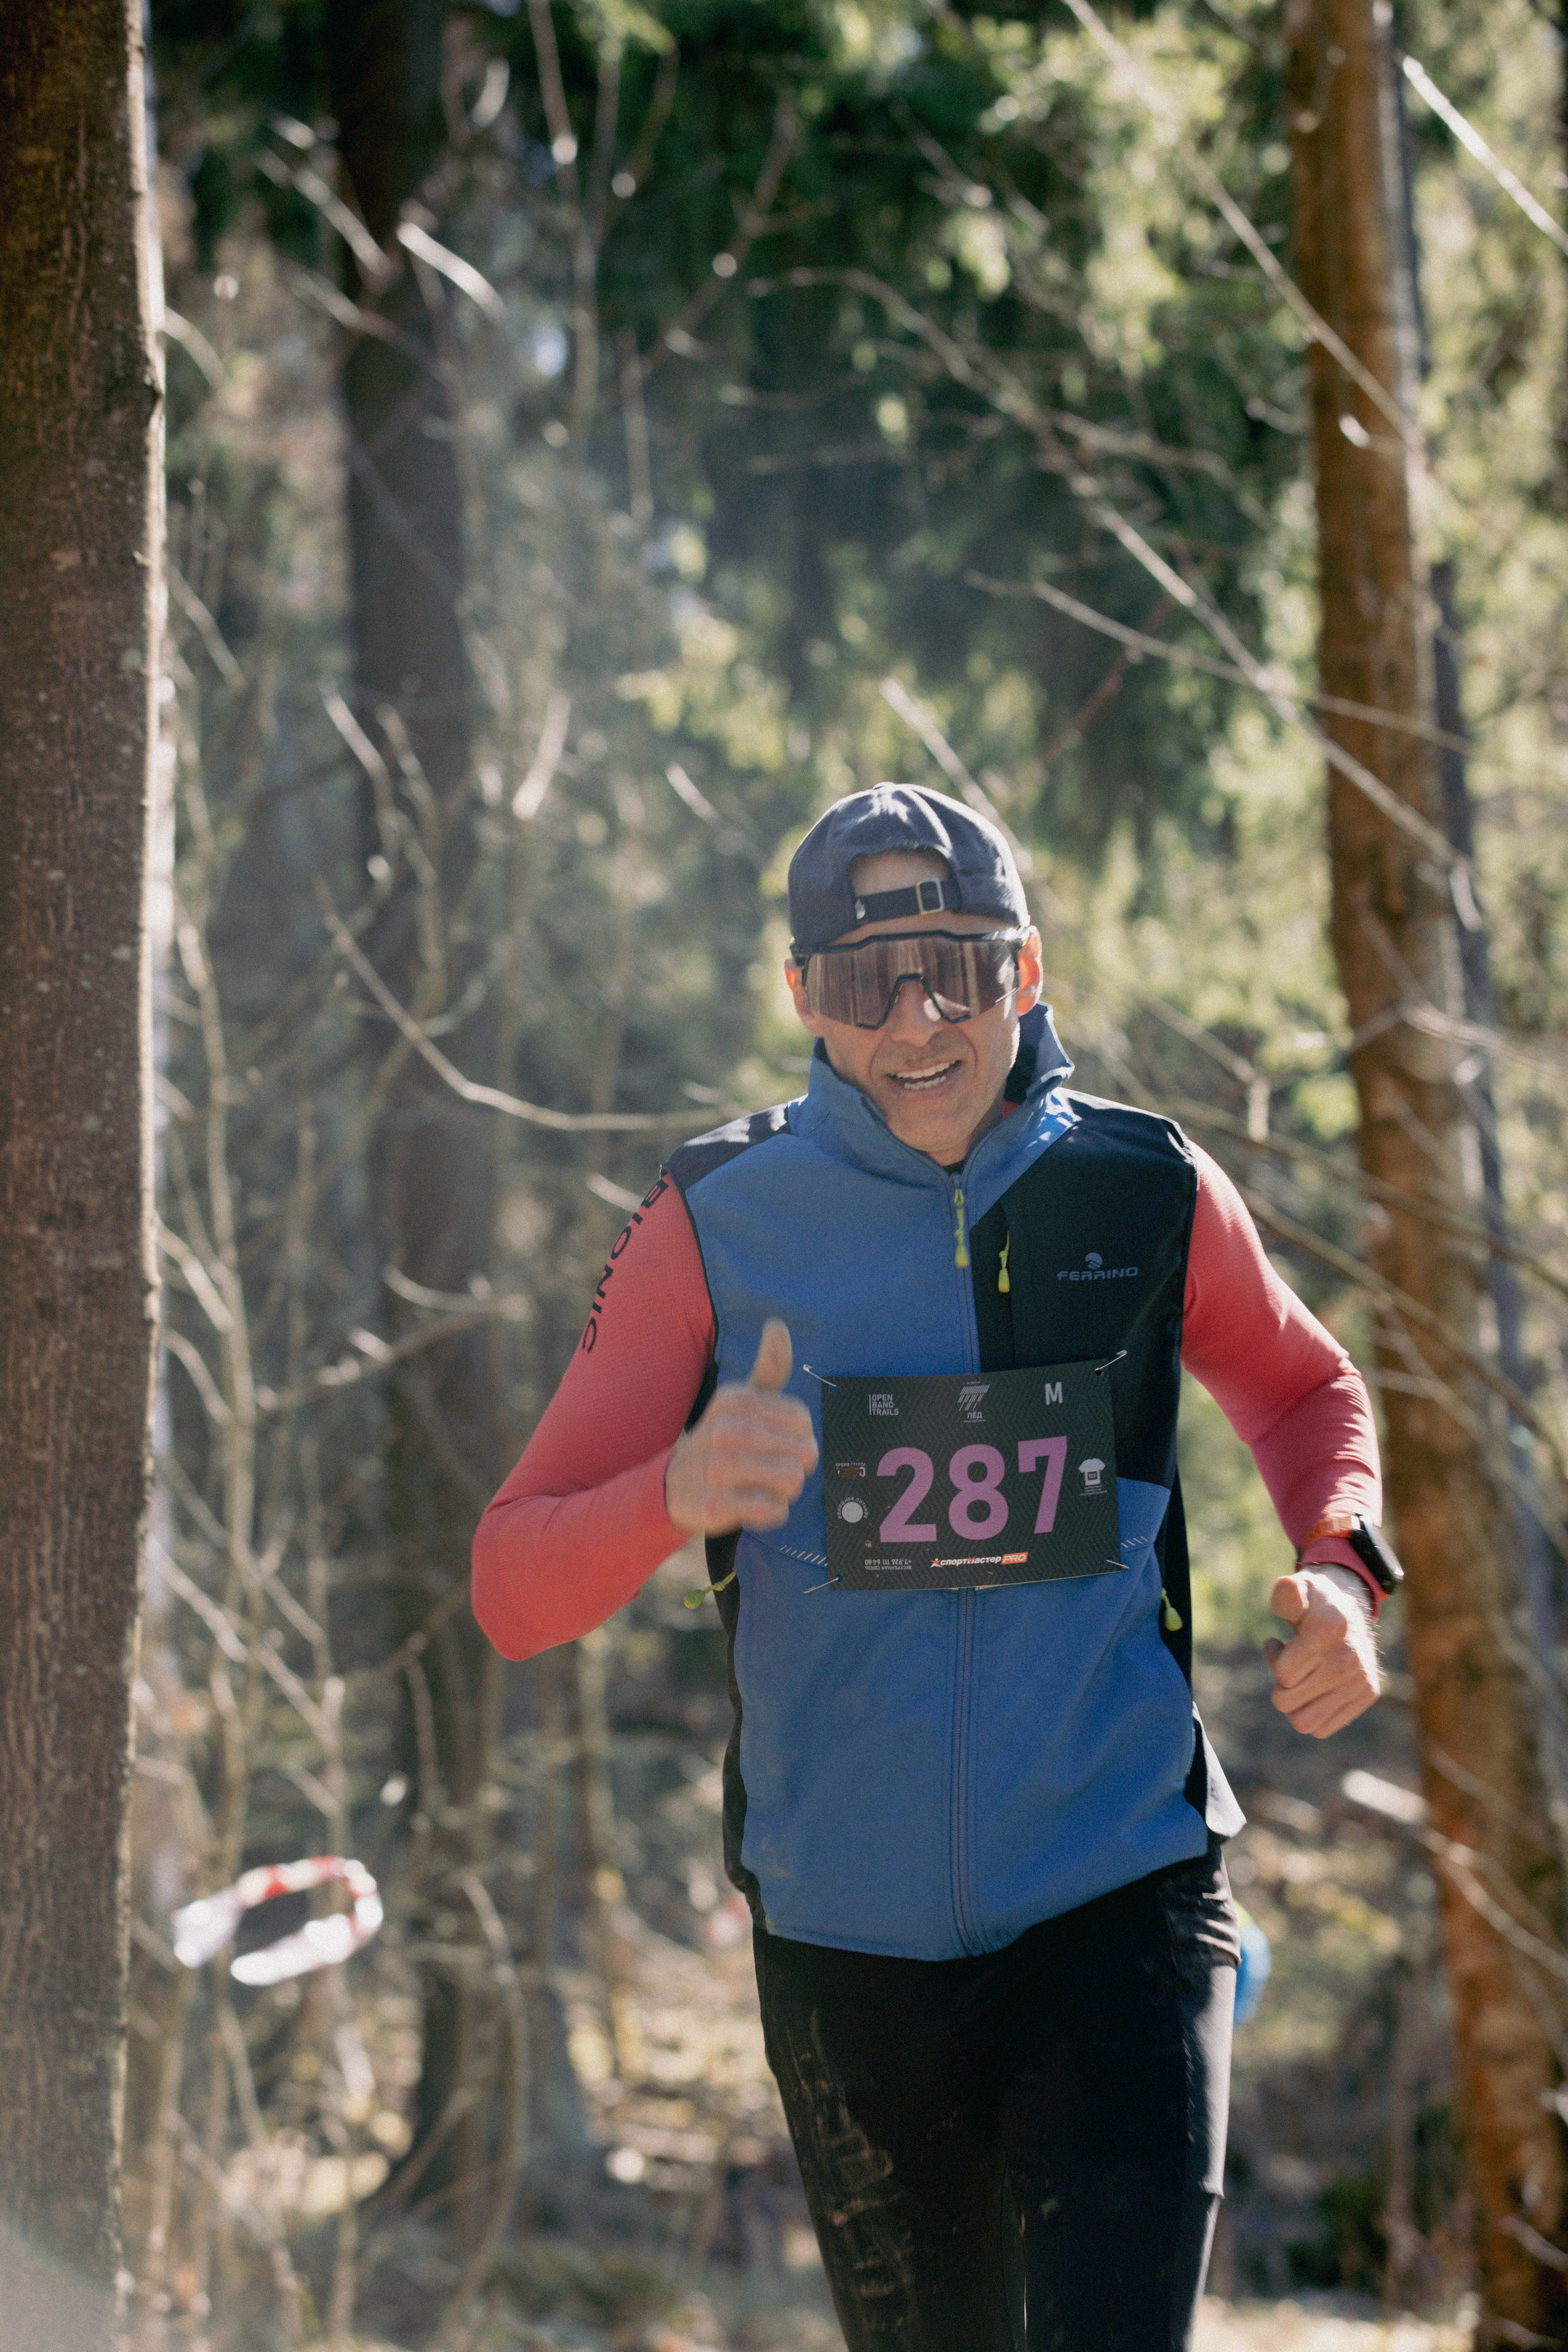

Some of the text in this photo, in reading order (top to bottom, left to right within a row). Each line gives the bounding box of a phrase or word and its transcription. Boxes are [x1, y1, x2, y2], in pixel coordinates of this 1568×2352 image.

[1057, 1267, 1139, 1281] FERRINO
[876, 1435, 1068, 1544] 287
[1002, 1554, 1027, 1562] PRO
